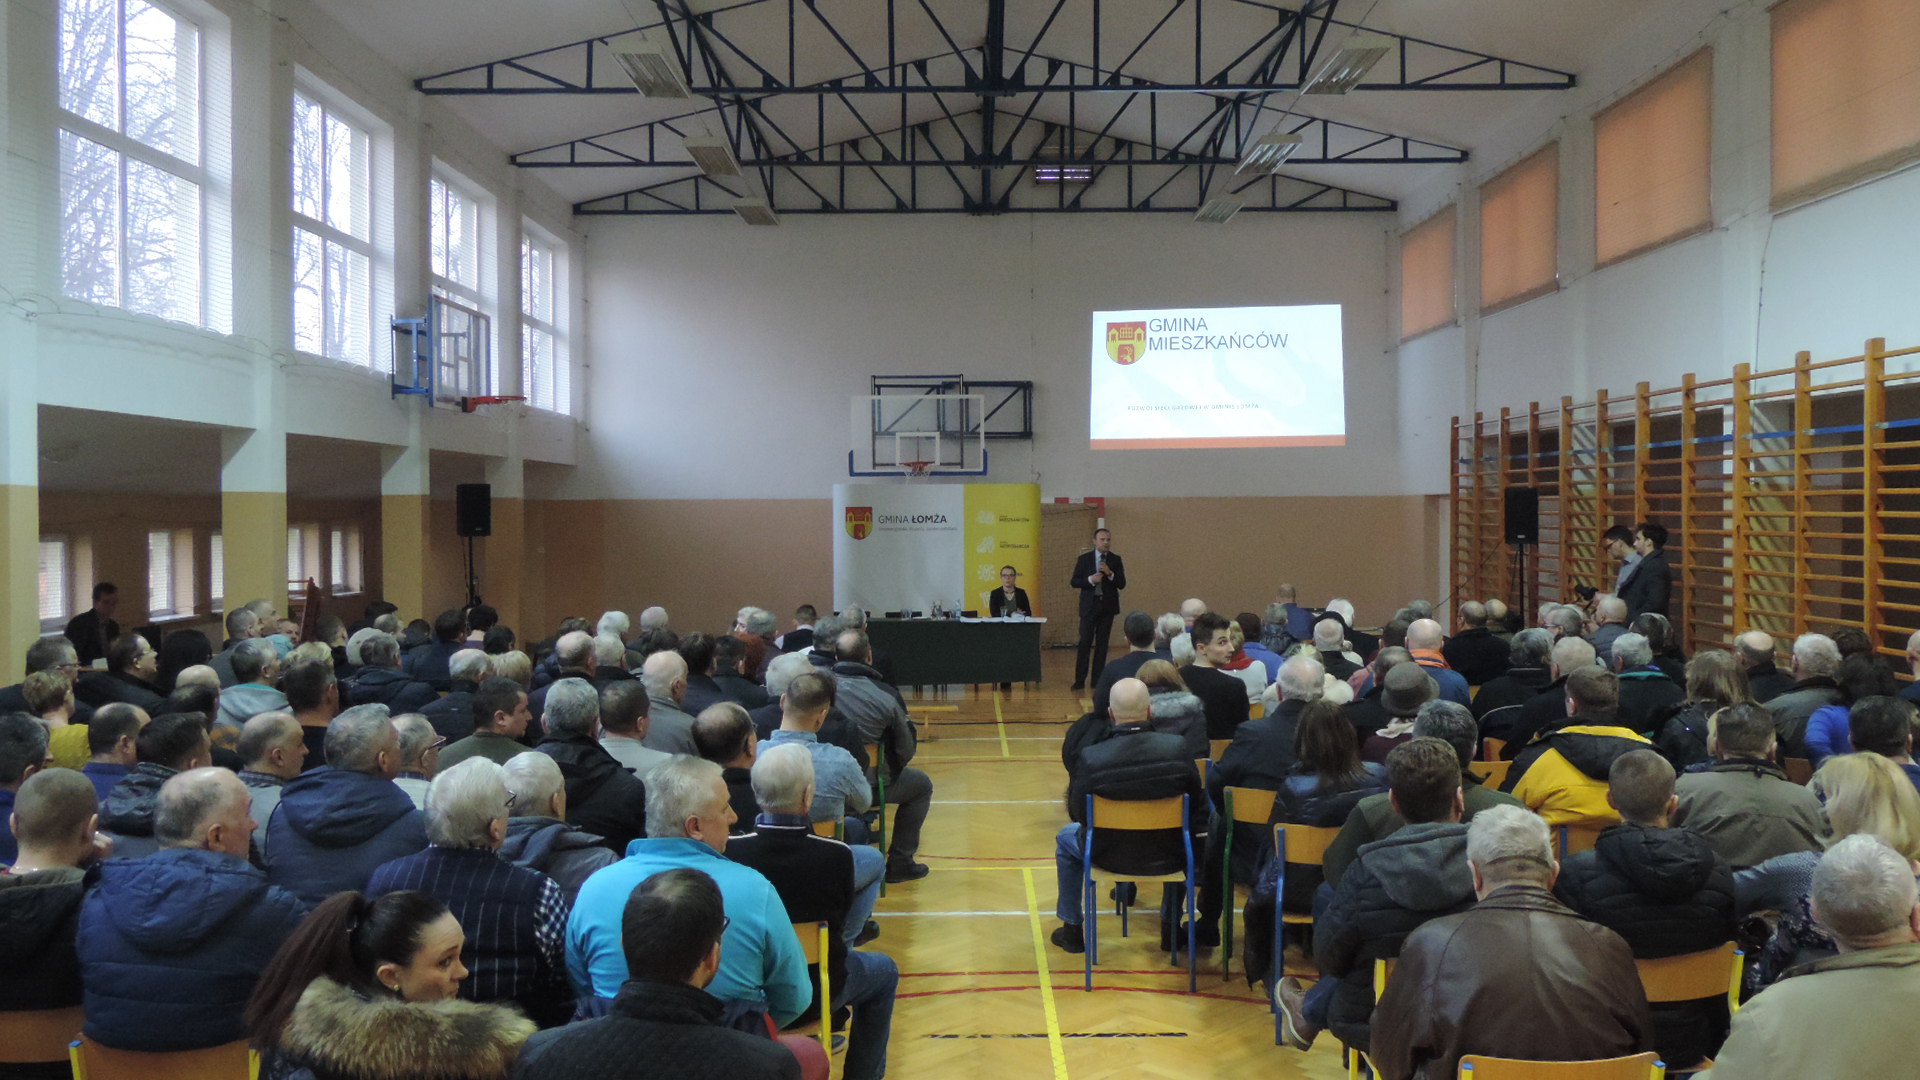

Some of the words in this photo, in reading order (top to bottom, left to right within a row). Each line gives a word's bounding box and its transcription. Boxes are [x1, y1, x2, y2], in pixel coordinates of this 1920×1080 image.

[1149, 317, 1208, 332] GMINA
[1149, 331, 1289, 350] MIESZKAŃCÓW
[878, 515, 909, 524] GMINA
[911, 513, 947, 524] ŁOMŻA
